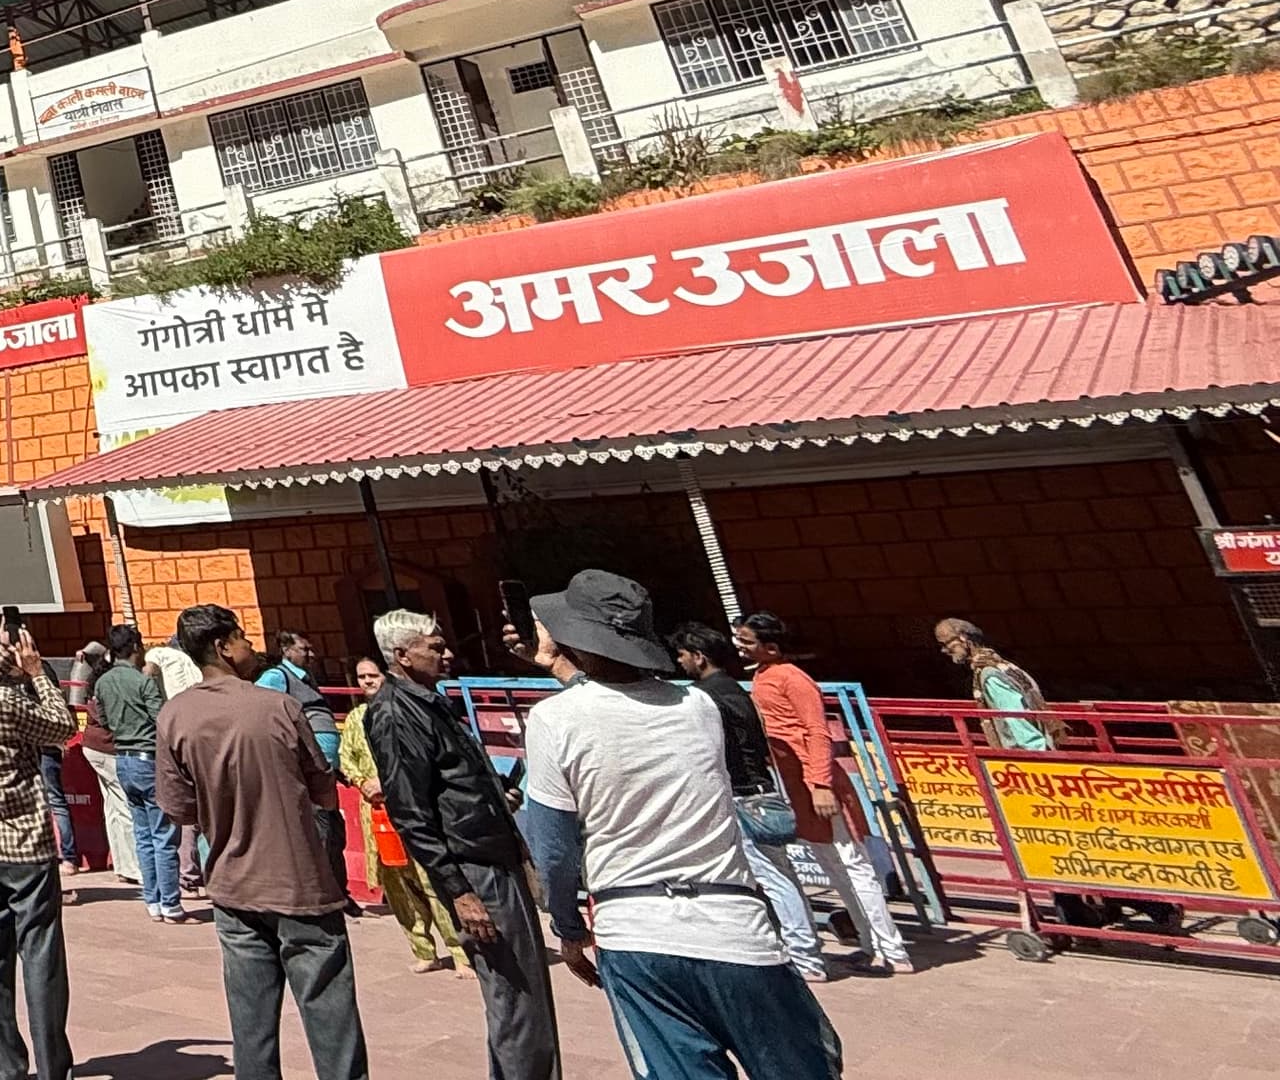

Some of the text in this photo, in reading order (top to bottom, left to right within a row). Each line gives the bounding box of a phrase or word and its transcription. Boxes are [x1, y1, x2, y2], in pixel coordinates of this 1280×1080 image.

[444, 198, 1027, 339] अमर उजाला
[137, 309, 226, 352] गंगोत्री
[125, 331, 365, 398] आपका स्वागत है
[991, 763, 1033, 797] श्री
[1097, 807, 1136, 825] धाम
[1011, 825, 1075, 847] आपका
[1153, 860, 1217, 888] करती
